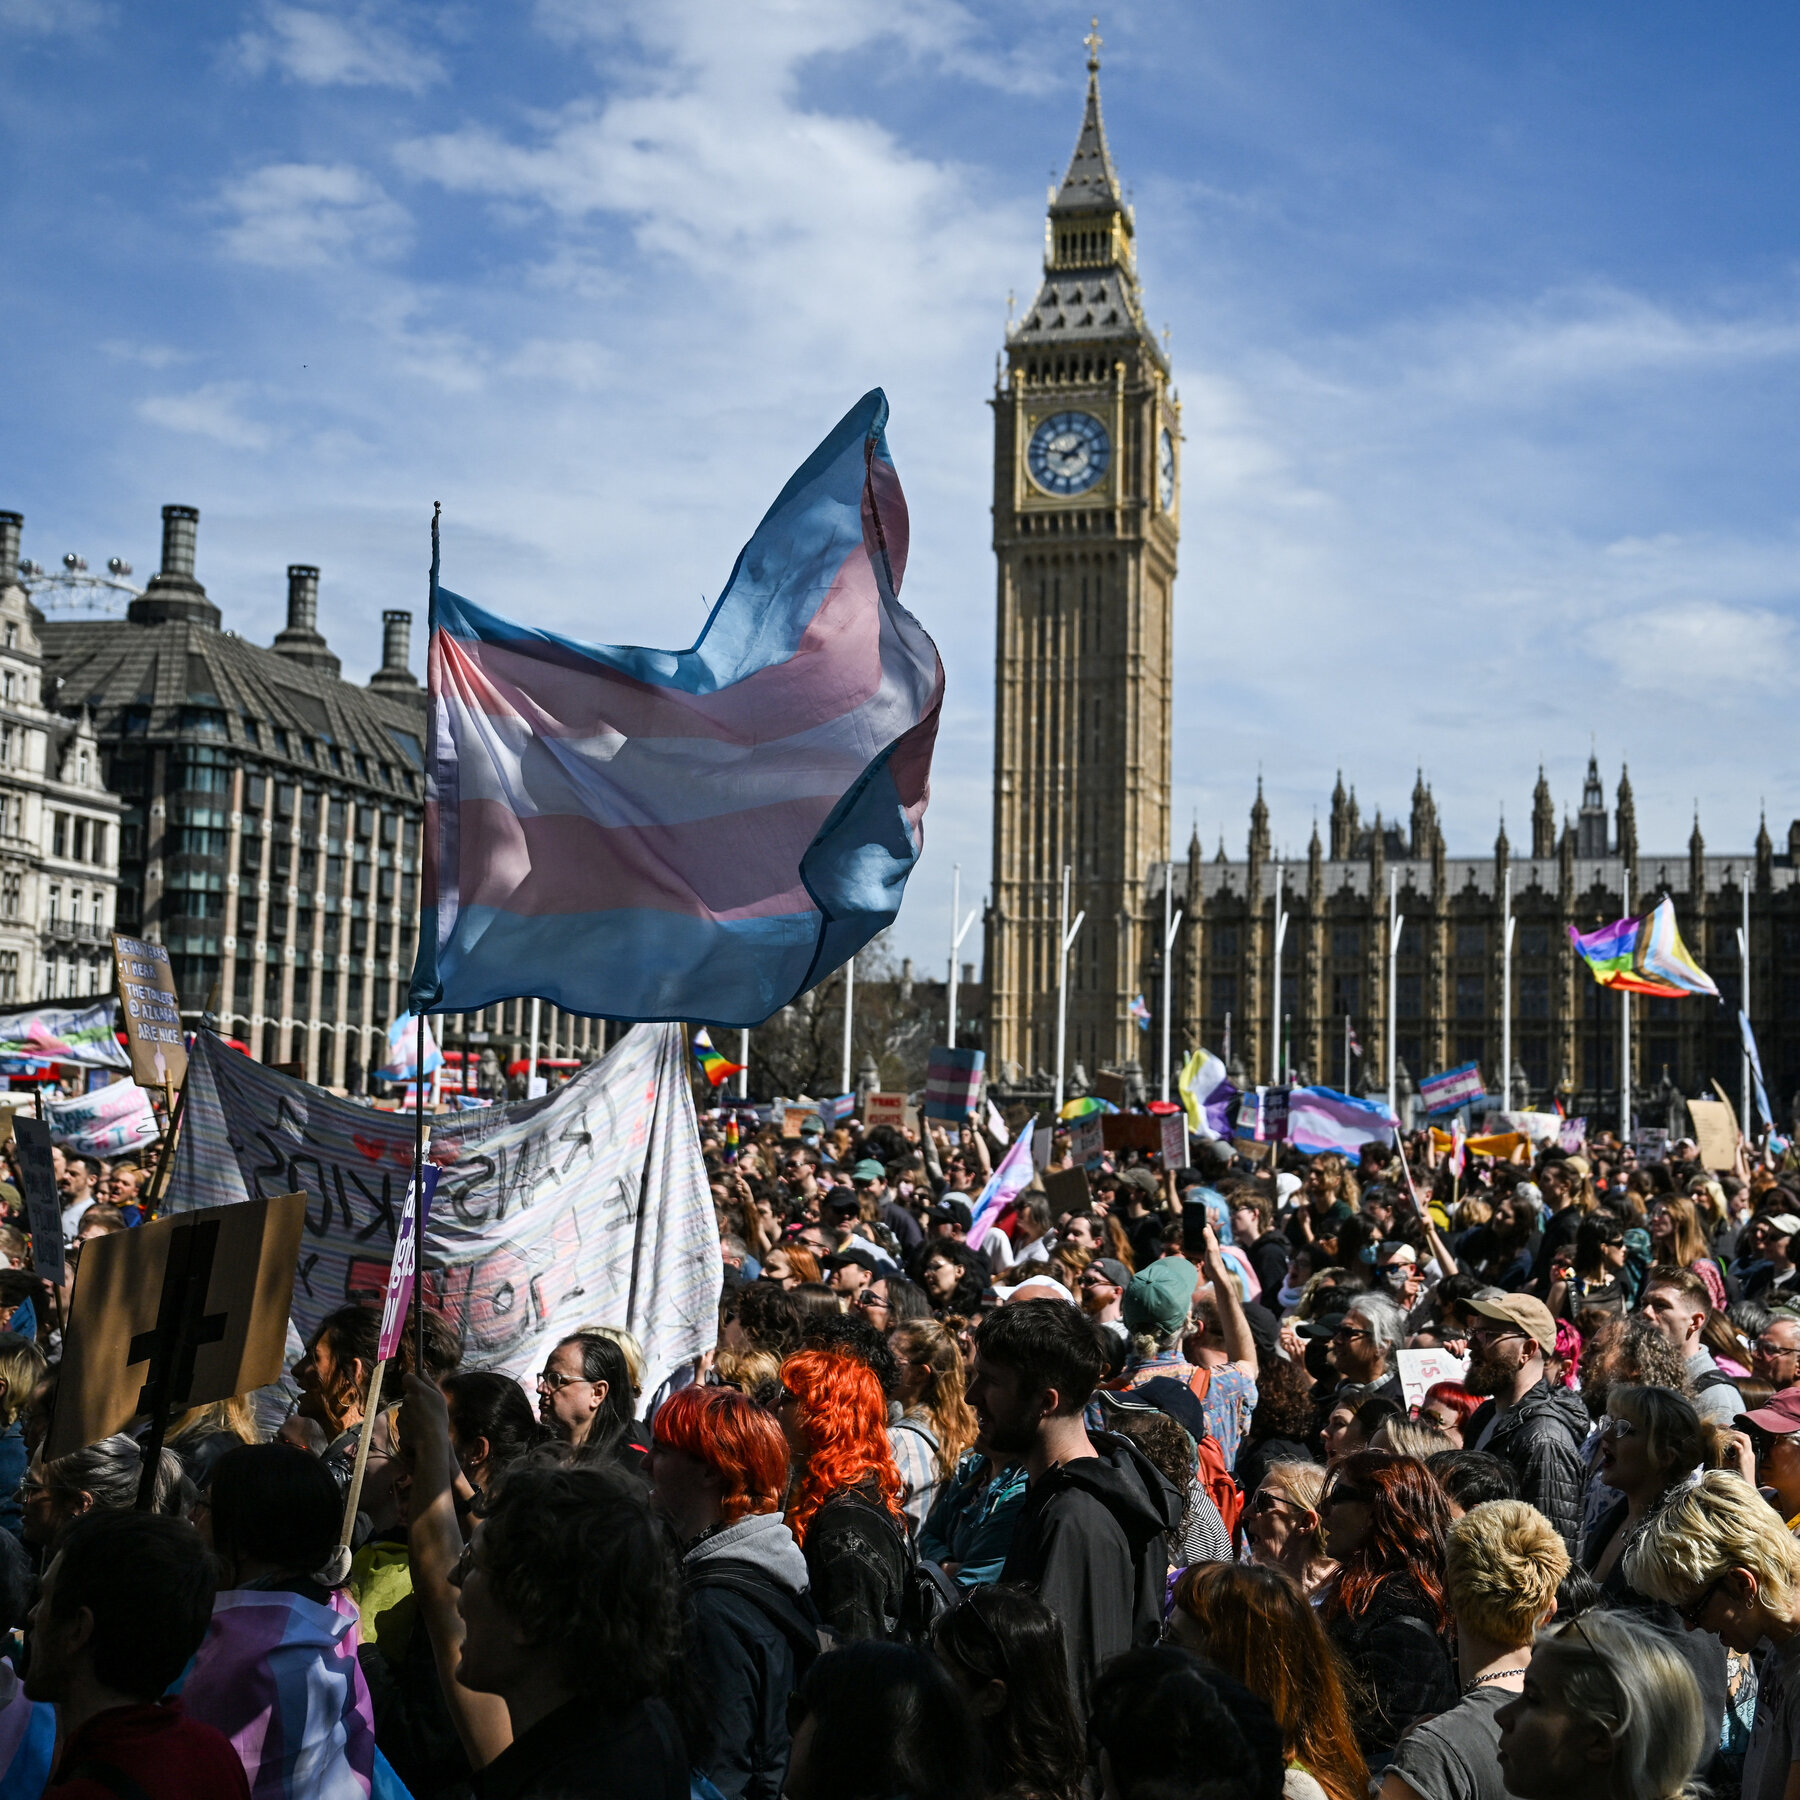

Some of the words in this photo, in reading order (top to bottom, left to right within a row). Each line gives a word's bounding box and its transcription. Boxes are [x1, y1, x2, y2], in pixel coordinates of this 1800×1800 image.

[123, 959, 129, 976] I
[131, 960, 157, 979] HEAR
[125, 982, 147, 1001] THE
[128, 998, 140, 1018] @
[137, 1022, 159, 1042] ARE
